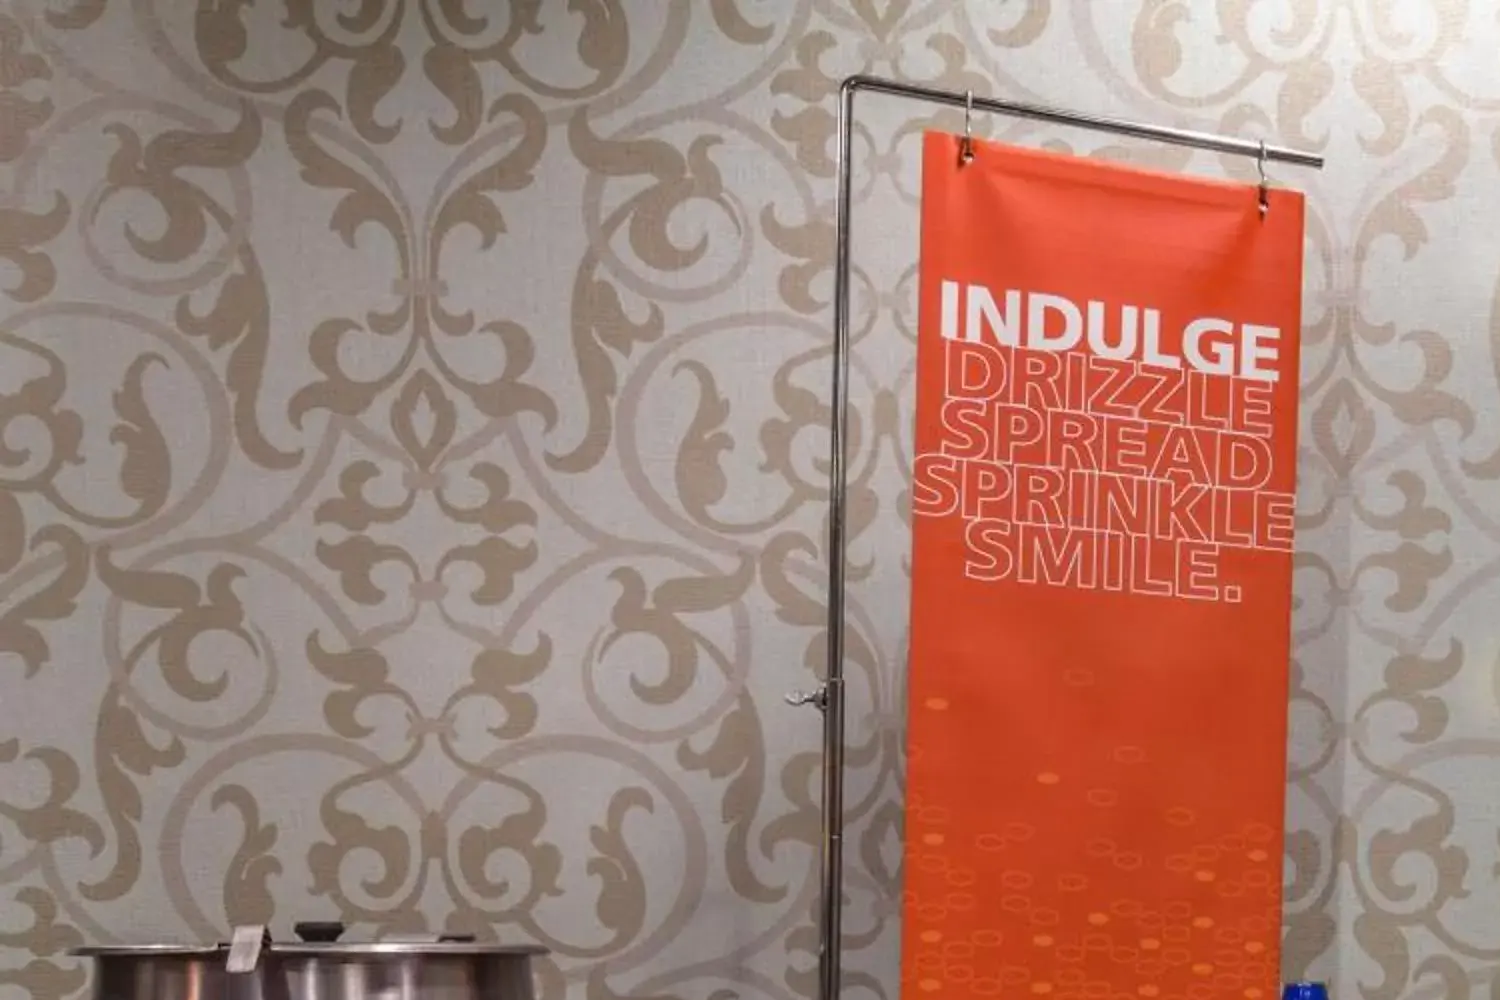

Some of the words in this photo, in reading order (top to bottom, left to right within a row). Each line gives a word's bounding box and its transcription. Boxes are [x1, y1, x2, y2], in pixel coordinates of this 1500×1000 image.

[940, 281, 1280, 381] INDULGE
[945, 339, 1275, 438] DRIZZLE
[940, 399, 1273, 490] SPREAD
[912, 453, 1296, 552] SPRINKLE
[965, 518, 1241, 602] SMILE.
